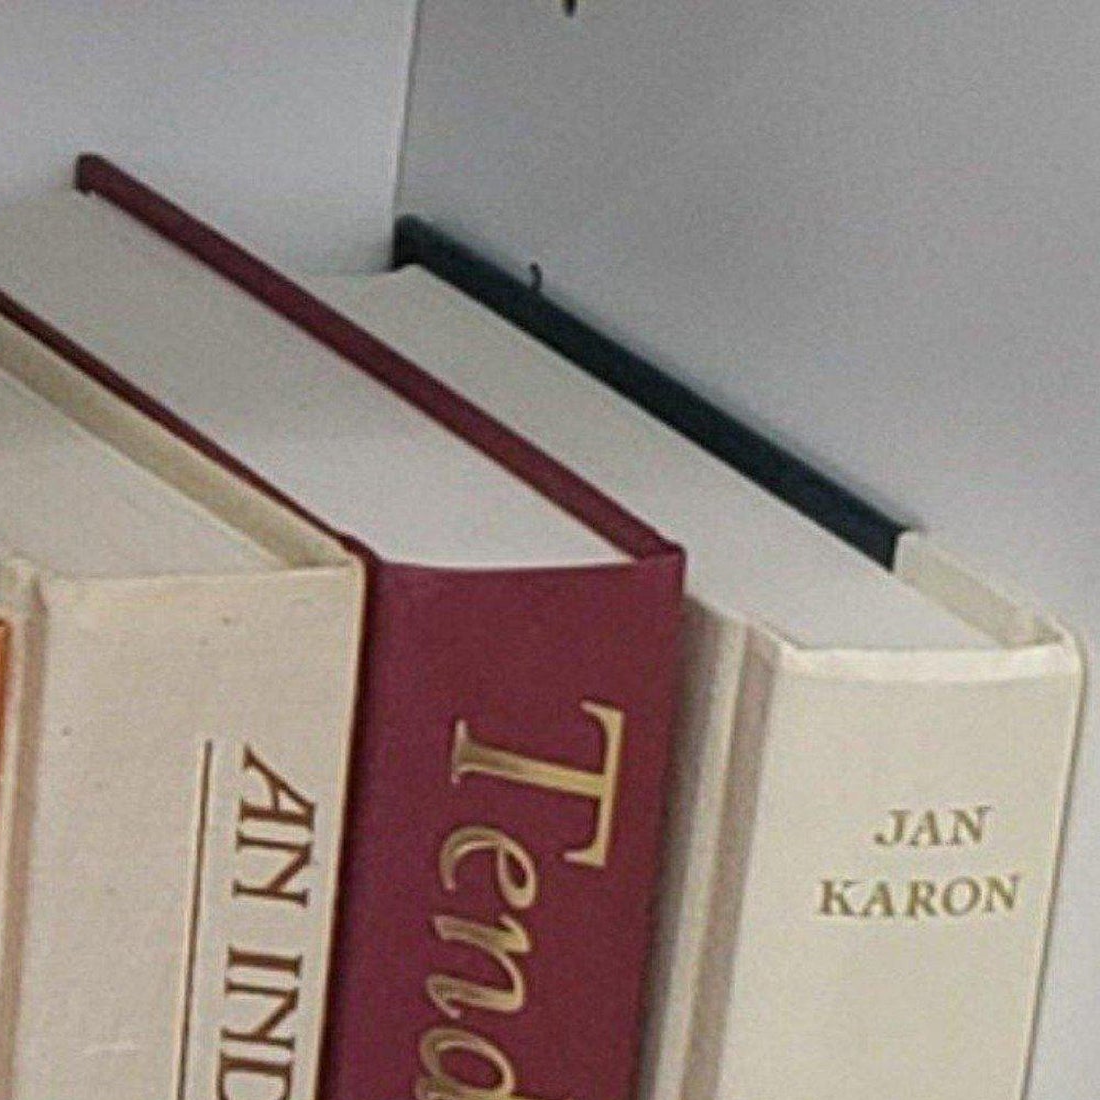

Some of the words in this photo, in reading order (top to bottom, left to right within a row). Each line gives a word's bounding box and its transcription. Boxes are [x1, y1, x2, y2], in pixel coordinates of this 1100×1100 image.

[231, 744, 316, 908] AN
[873, 805, 992, 849] JAN
[817, 873, 1022, 918] KARON
